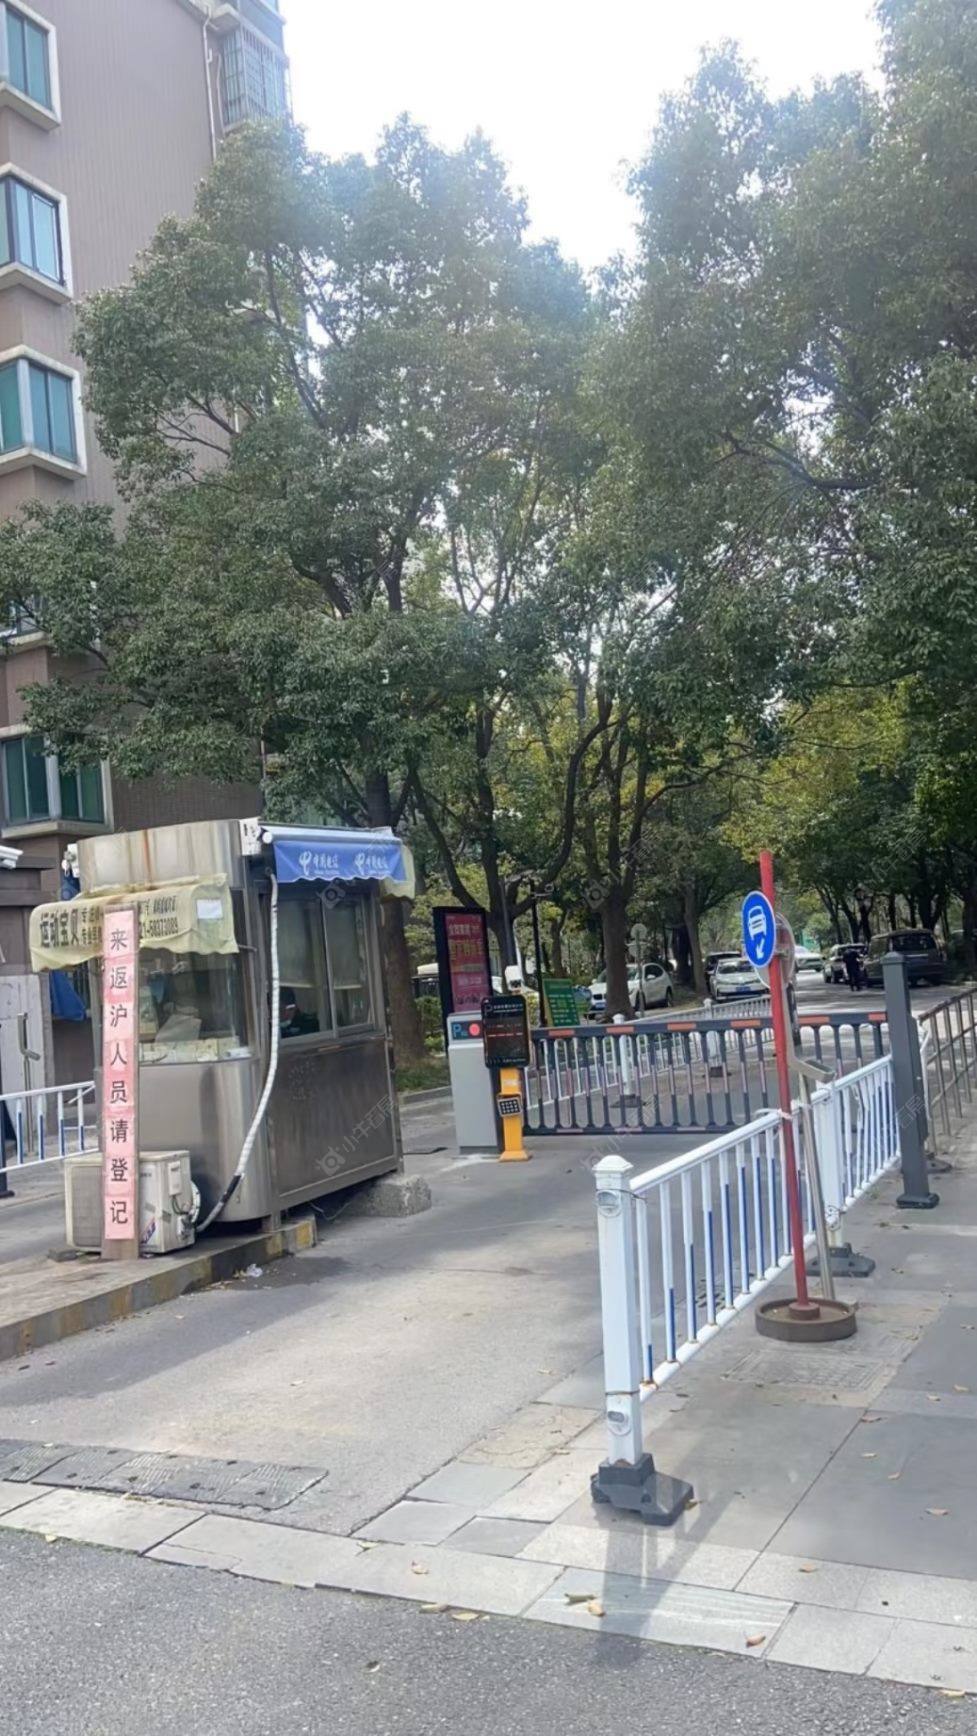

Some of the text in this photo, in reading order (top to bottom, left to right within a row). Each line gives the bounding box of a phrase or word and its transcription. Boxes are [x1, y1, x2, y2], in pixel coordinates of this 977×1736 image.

[109, 928, 129, 1225] 来返沪人员请登记
